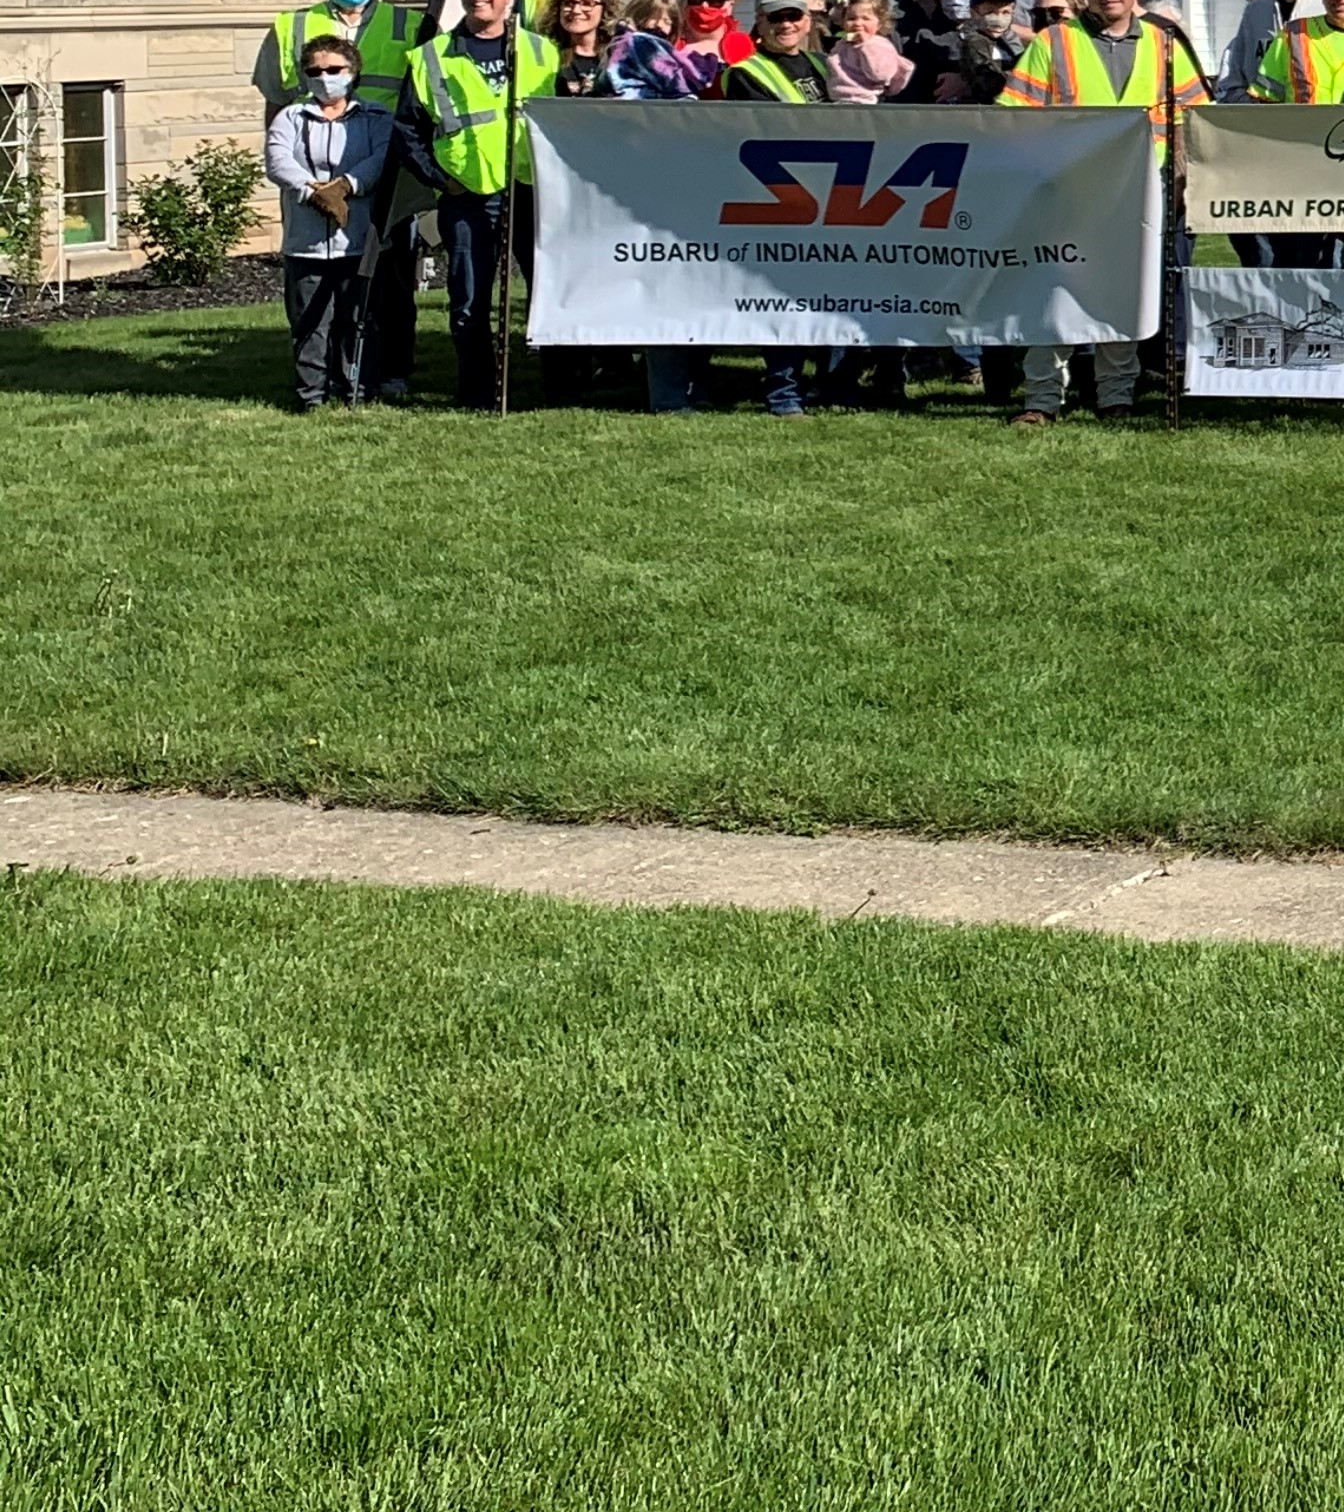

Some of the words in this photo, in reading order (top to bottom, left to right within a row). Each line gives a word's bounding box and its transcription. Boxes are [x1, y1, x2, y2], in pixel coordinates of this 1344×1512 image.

[1210, 200, 1293, 219] URBAN
[614, 242, 719, 263] SUBARU
[727, 241, 749, 263] of
[756, 242, 857, 264] INDIANA
[865, 243, 1027, 270] AUTOMOTIVE,
[1035, 243, 1086, 264] INC.
[734, 294, 961, 317] www.subaru-sia.com
